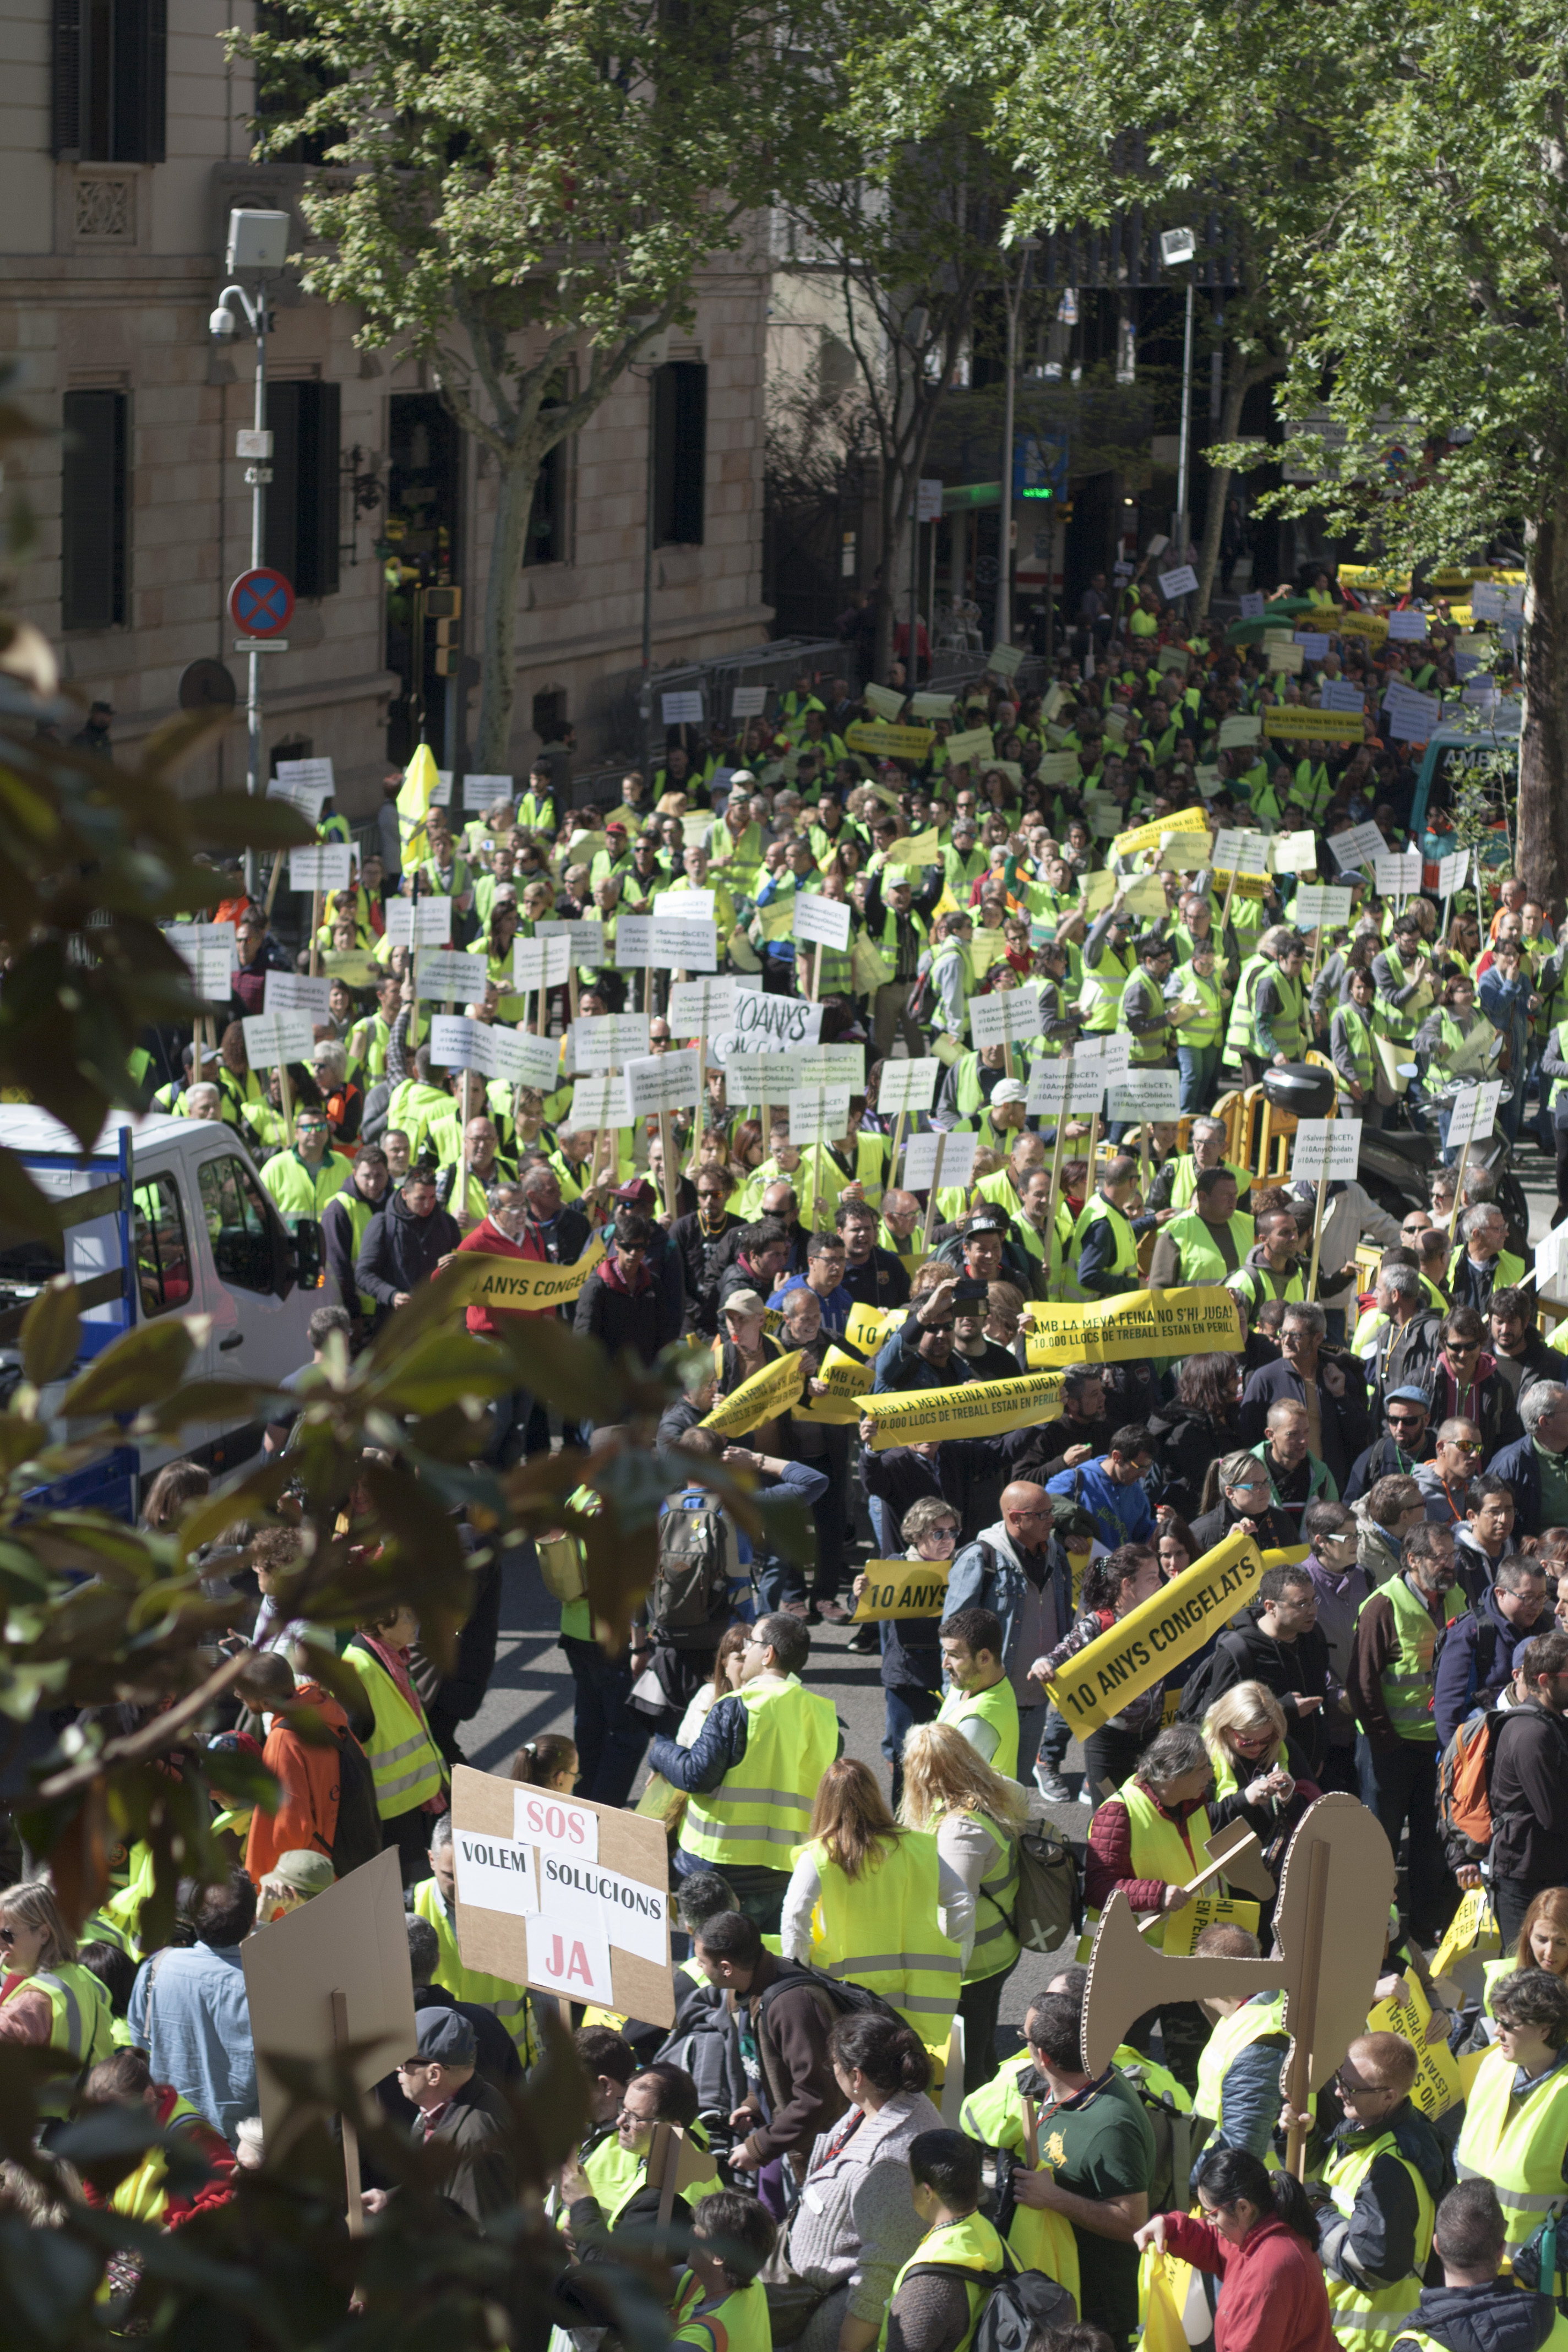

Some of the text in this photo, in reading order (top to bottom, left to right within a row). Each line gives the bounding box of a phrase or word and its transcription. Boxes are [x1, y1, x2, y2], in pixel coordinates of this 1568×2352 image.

[978, 999, 1032, 1015] #SalvemElsCETs
[978, 1009, 1033, 1025] #10AnysOblidats
[977, 1017, 1036, 1035] #10AnysCongelats
[1033, 1092, 1099, 1101] #10AnysCongelats
[1037, 1082, 1097, 1090] #10AnysOblidats
[1303, 1134, 1354, 1142] #SalvemElsCETs
[1301, 1145, 1353, 1154] #10AnysOblidats
[1298, 1156, 1354, 1166] #10AnysCongelats
[482, 1275, 530, 1295] ANYS
[1033, 1305, 1233, 1335] AMB LA MEVA FEINA NO S'HI JUGA!
[857, 1324, 876, 1345] 10
[1035, 1321, 1234, 1349] 10.000 LLOCS DE TREBALL ESTAN EN PERILL
[823, 1366, 865, 1389] AMB LA
[873, 1375, 1061, 1417] AMB LA MEVA FEINA NO S'HI JUGA!
[875, 1389, 1061, 1430] 10.000 LLOCS DE TREBALL ESTAN EN PERILL
[871, 1583, 950, 1608] 10 ANYS
[1066, 1683, 1098, 1716] 10
[1096, 1641, 1151, 1696] ANYS
[1148, 1555, 1256, 1652] CONGELATS
[526, 1800, 585, 1844] SOS
[461, 1841, 662, 1920] VOLEM SOLUCIONS
[1195, 1899, 1211, 1916] EN
[545, 1934, 595, 1987] JA
[1415, 2035, 1428, 2057] EN
[1422, 2054, 1449, 2098] ESTAN
